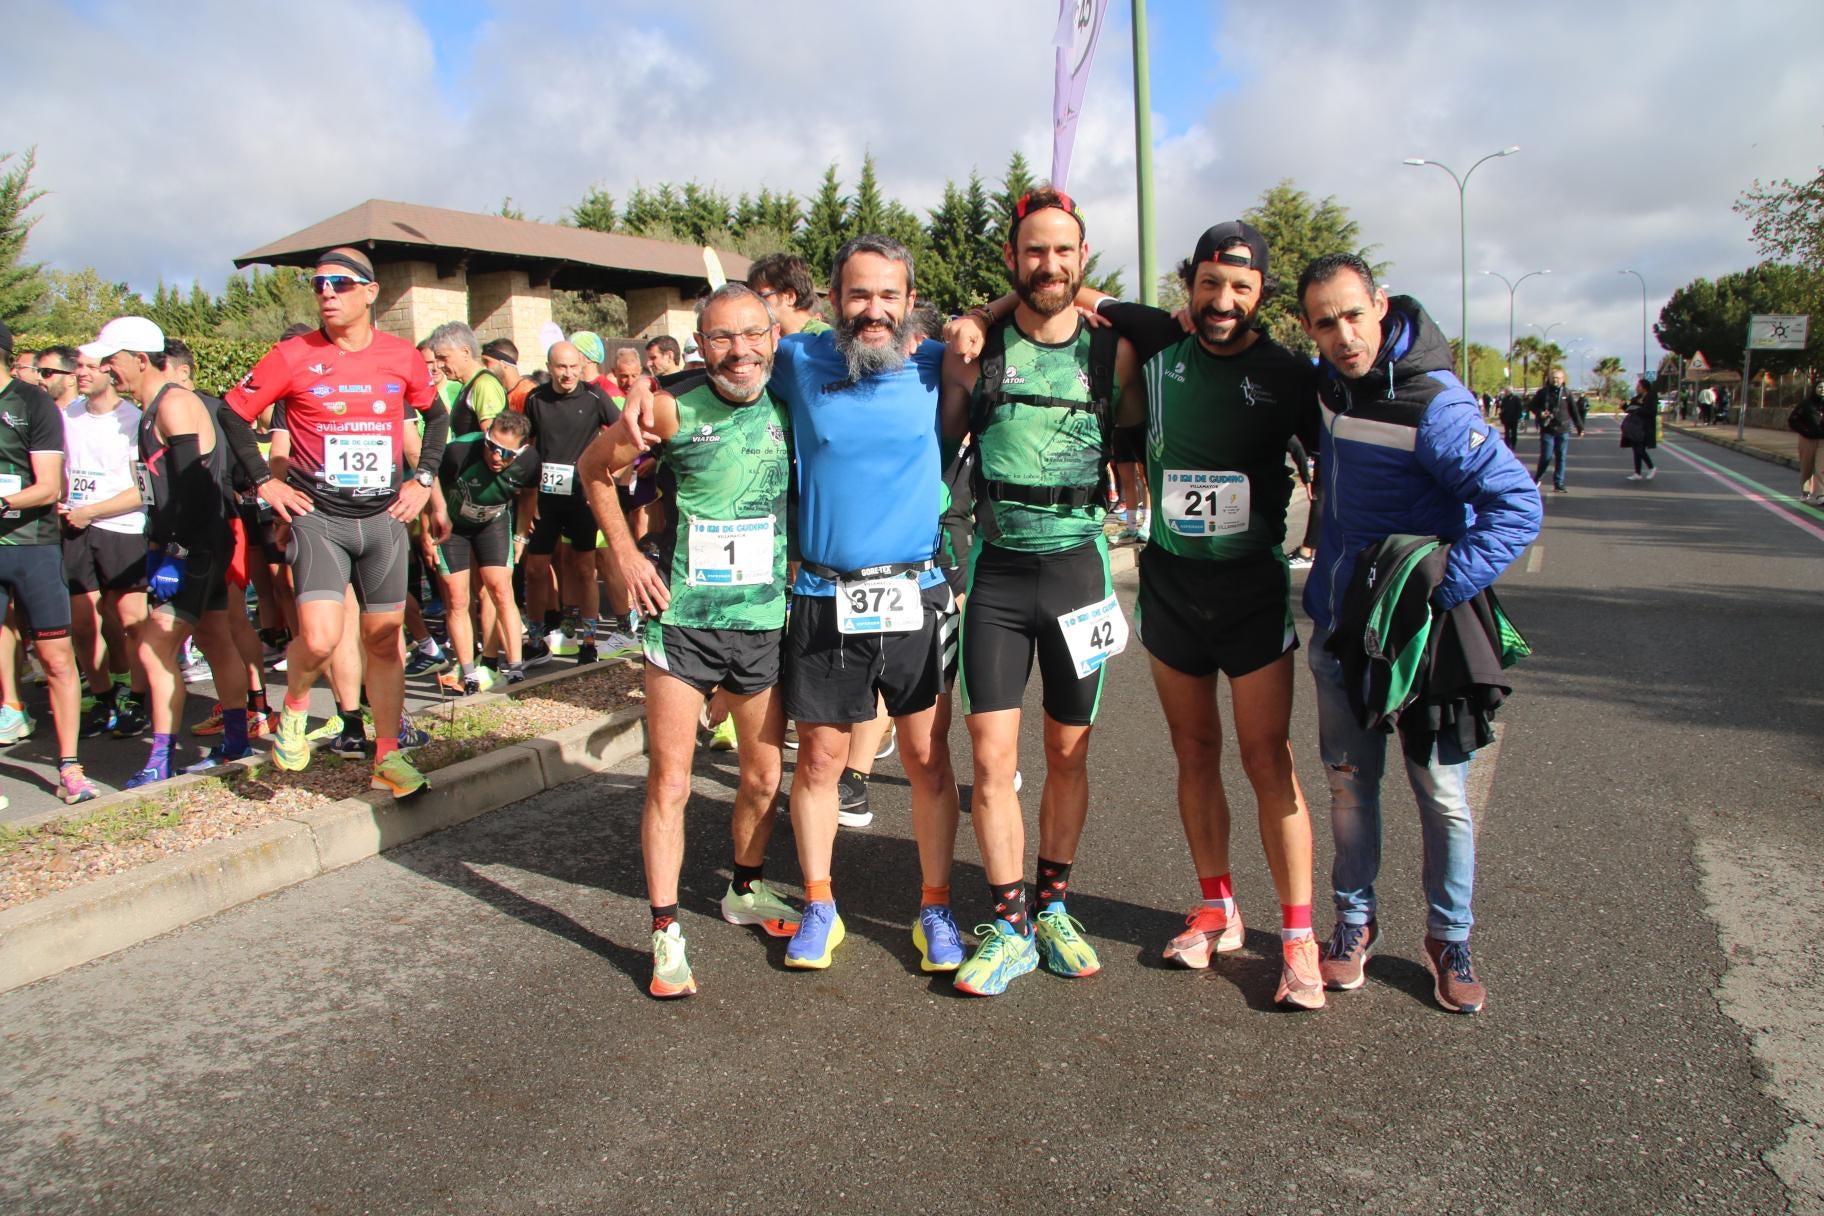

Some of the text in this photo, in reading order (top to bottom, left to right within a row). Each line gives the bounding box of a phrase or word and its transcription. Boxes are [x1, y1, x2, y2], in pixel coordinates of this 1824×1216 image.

[692, 435, 721, 443] VIATOR
[339, 451, 378, 471] 132
[73, 478, 96, 492] 204
[543, 472, 563, 486] 312
[1168, 474, 1178, 482] 10
[1179, 474, 1193, 482] KM
[1194, 474, 1207, 483] DE
[1184, 490, 1216, 516] 21
[695, 524, 705, 533] 10
[722, 525, 735, 533] DE
[723, 540, 734, 565] 1
[861, 565, 892, 577] GORE-TEX
[851, 587, 904, 614] 372
[1090, 621, 1115, 649] 42
